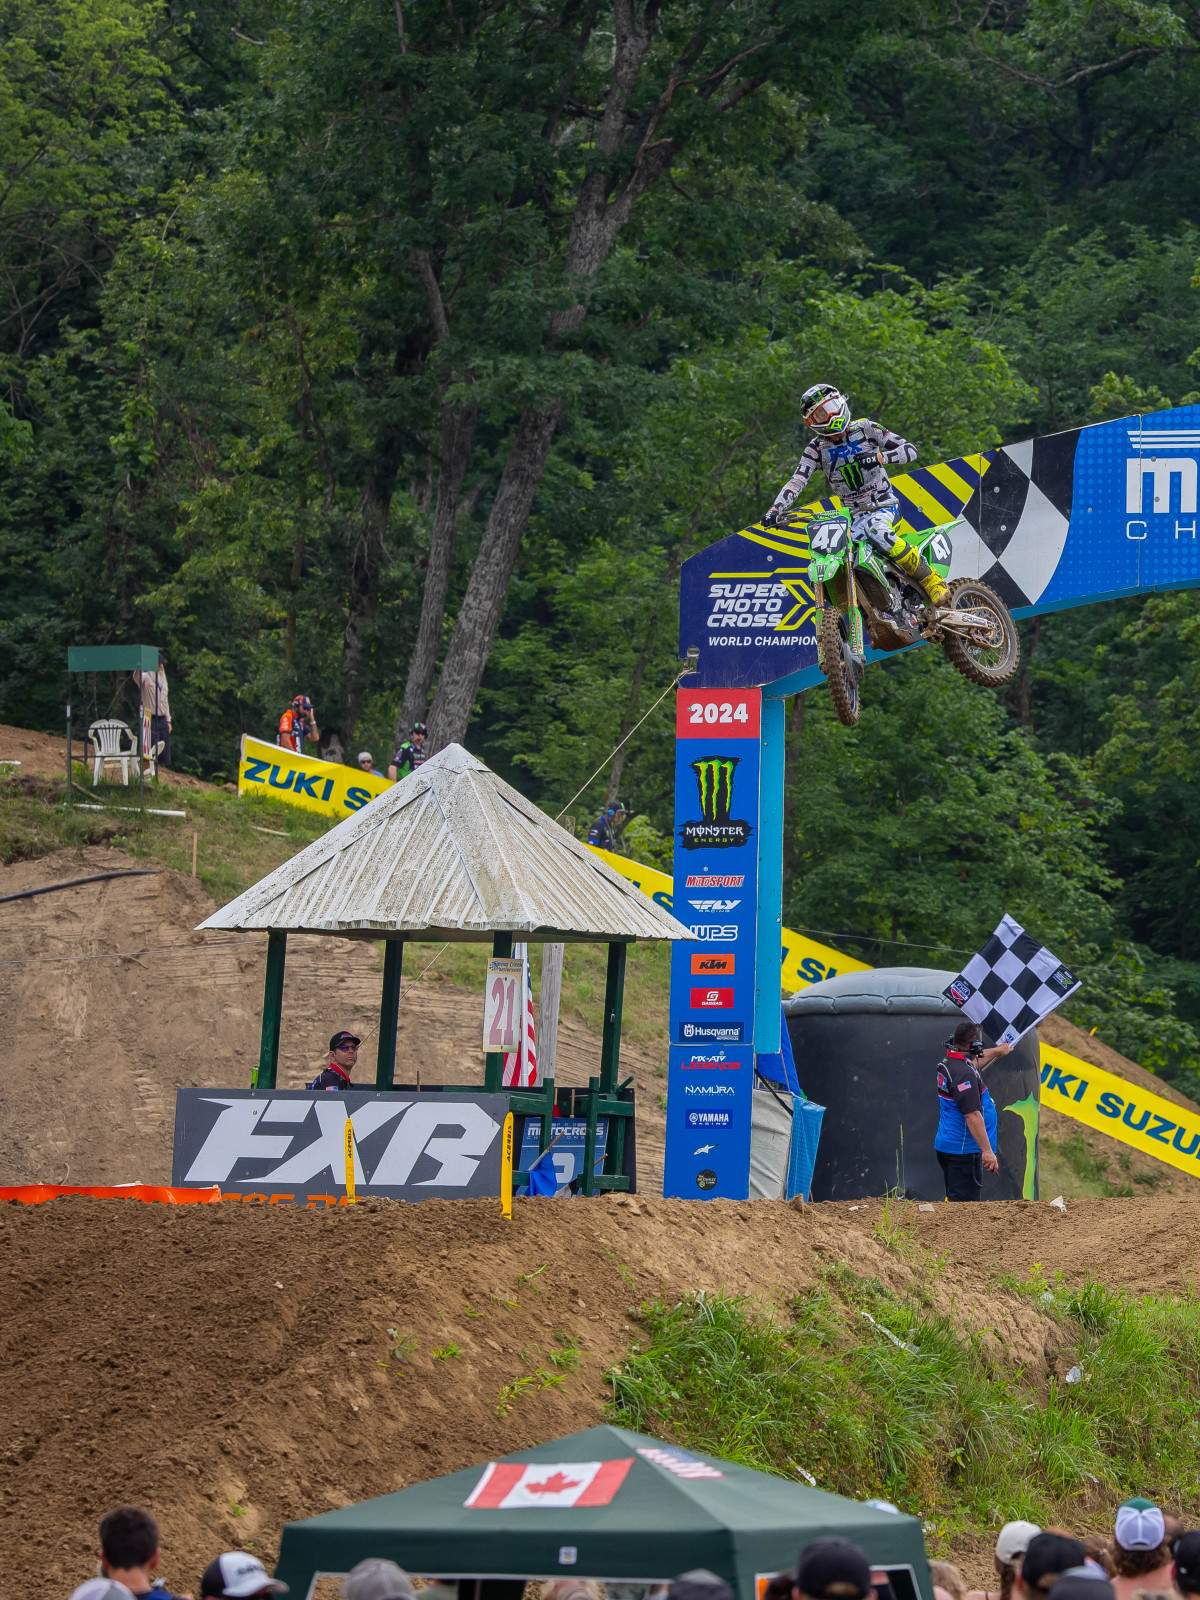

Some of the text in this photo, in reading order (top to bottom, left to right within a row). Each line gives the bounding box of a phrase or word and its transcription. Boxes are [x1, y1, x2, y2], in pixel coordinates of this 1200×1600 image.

[811, 523, 847, 550] 47
[931, 533, 951, 561] 47
[708, 583, 788, 598] SUPER
[712, 599, 782, 613] MOTO
[707, 613, 783, 628] CROSS
[708, 636, 752, 647] WORLD
[689, 702, 749, 724] 2024
[244, 755, 336, 802] ZUKI
[686, 825, 744, 837] MONSTER
[699, 959, 727, 970] KTM
[489, 976, 515, 1046] 21
[694, 1027, 739, 1037] Husqvarna
[681, 1062, 741, 1071] LEGENDS
[685, 1085, 735, 1094] NAMURA
[698, 1113, 729, 1122] YAMAHA
[184, 1097, 501, 1187] FXR
